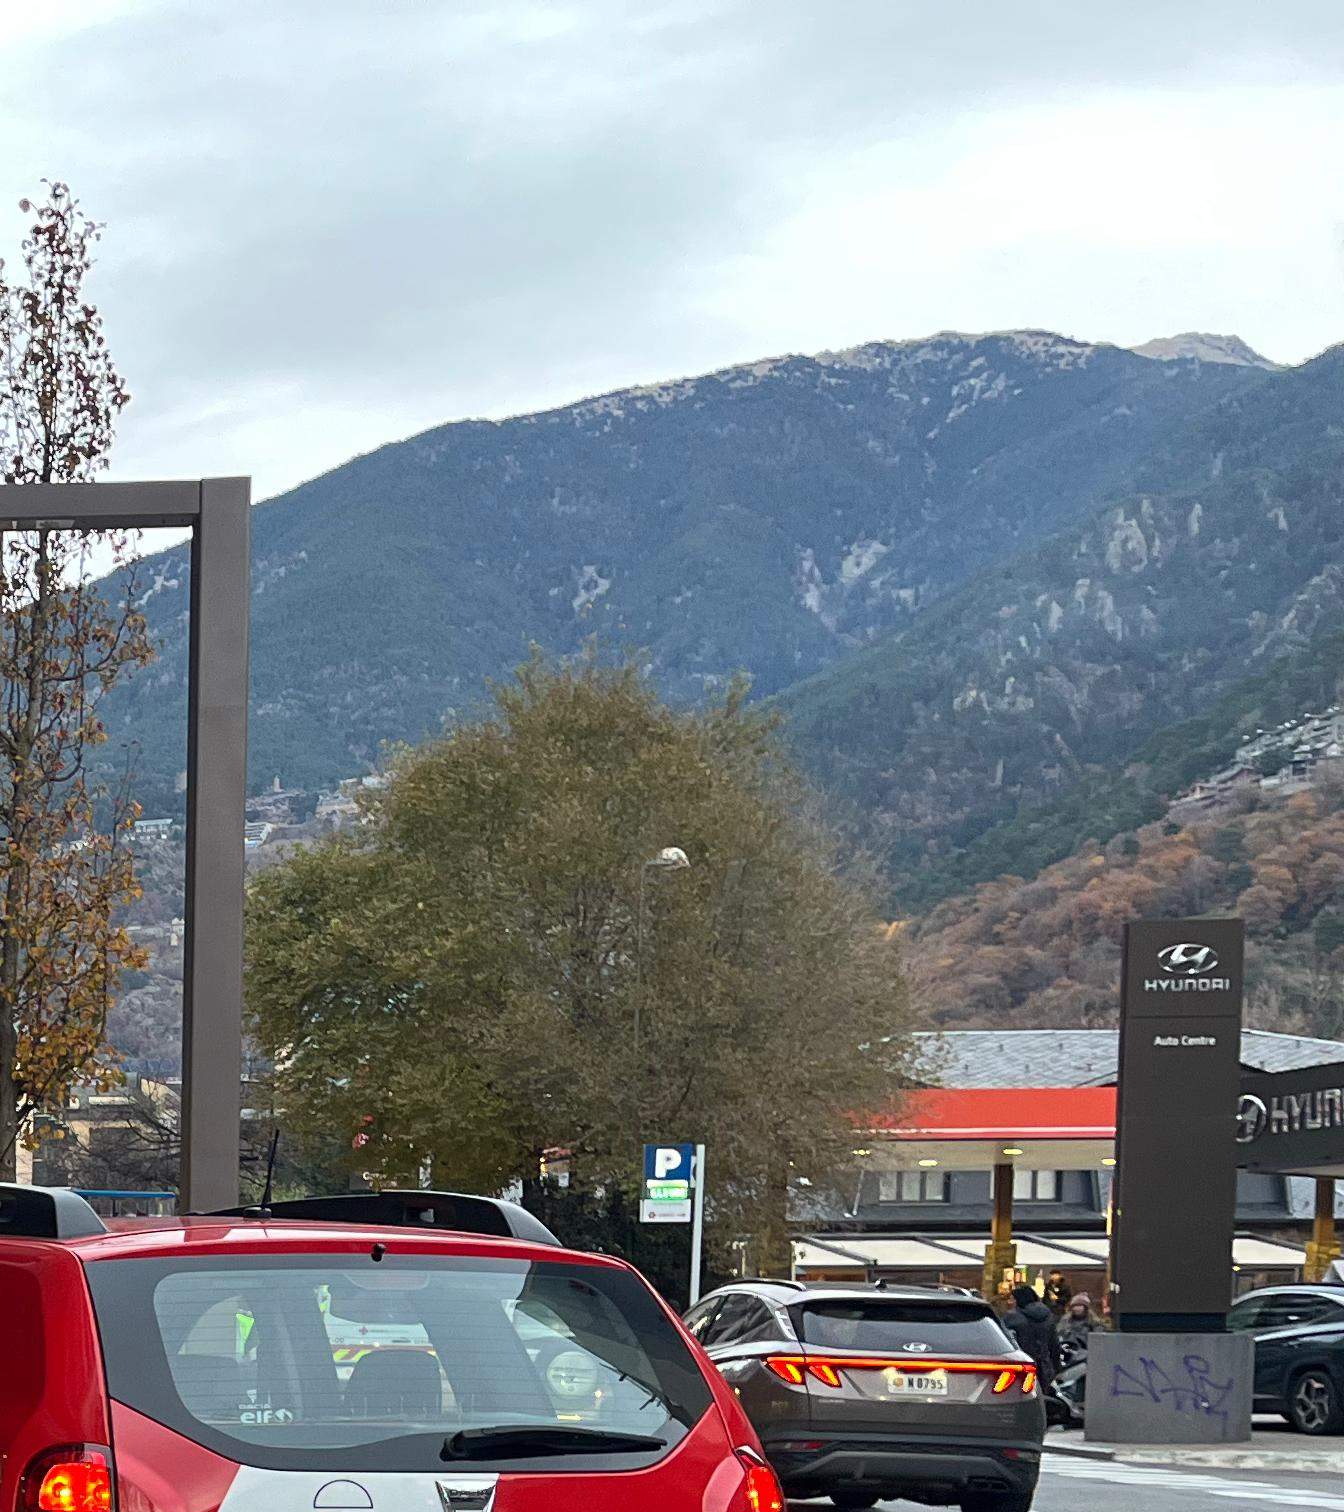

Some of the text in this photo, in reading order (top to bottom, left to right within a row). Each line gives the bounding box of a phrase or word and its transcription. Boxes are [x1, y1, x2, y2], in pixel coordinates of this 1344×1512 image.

[1144, 978, 1230, 992] HYUNDAI
[1154, 1034, 1216, 1046] Auto Centre
[1271, 1088, 1344, 1134] HYUN
[655, 1148, 682, 1178] P
[240, 1409, 273, 1424] elf
